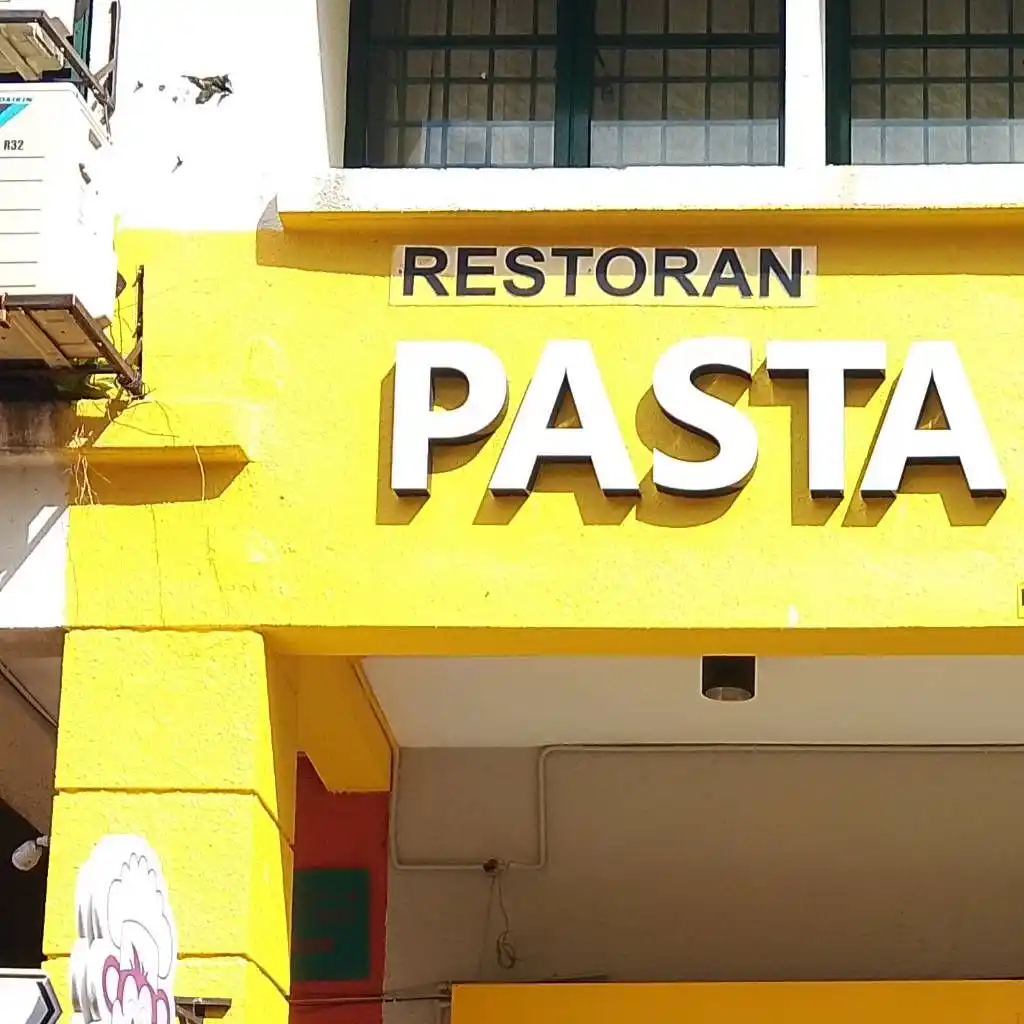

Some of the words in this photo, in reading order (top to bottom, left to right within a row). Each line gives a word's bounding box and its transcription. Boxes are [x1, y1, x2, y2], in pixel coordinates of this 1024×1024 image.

[3, 139, 24, 151] R32
[401, 246, 802, 298] RESTORAN
[390, 336, 1008, 500] PASTA
